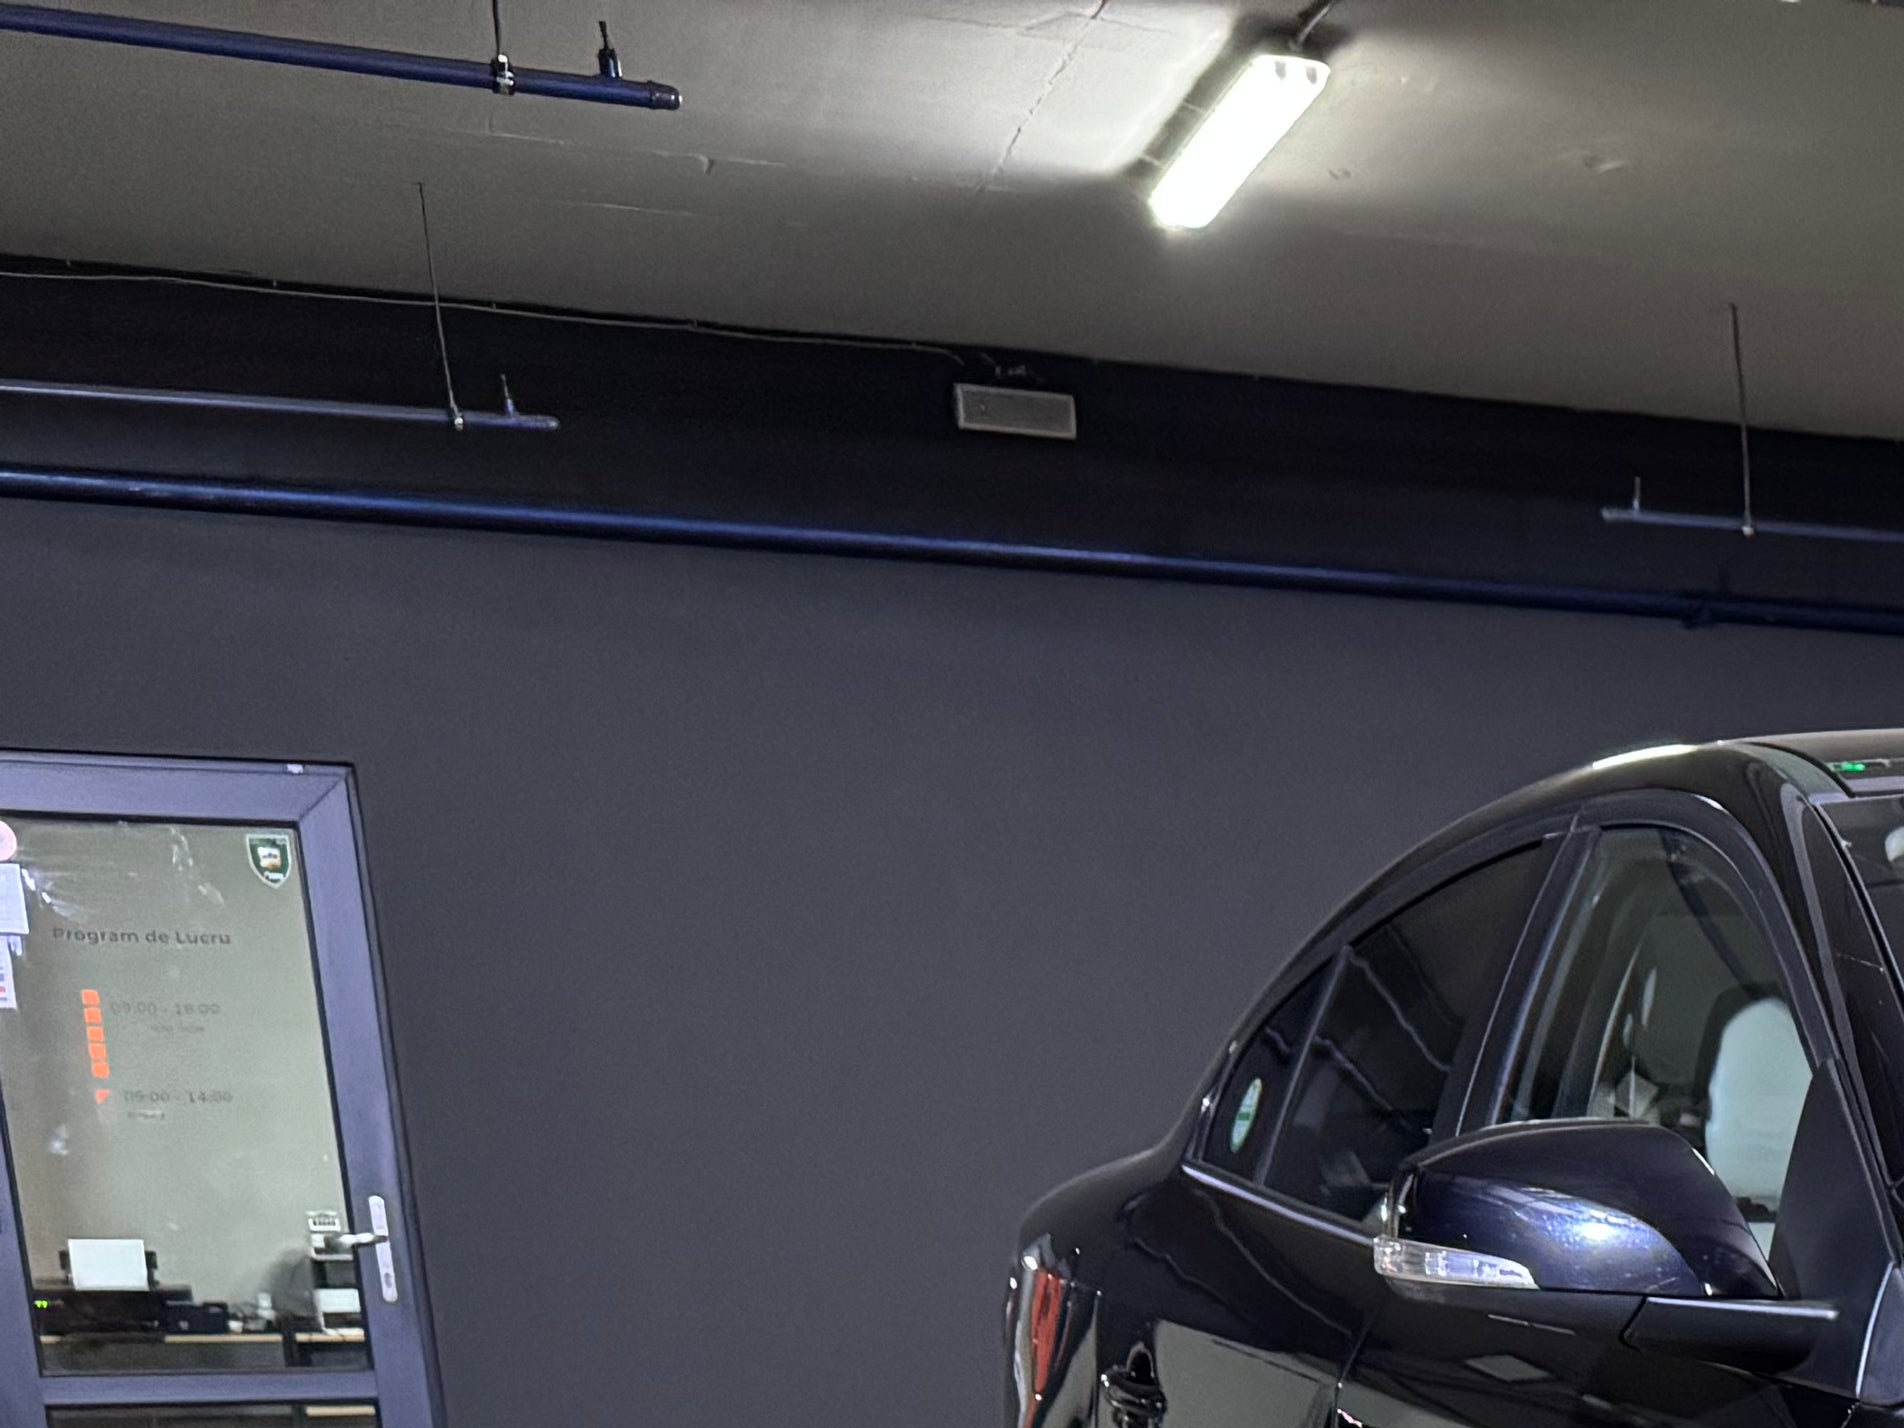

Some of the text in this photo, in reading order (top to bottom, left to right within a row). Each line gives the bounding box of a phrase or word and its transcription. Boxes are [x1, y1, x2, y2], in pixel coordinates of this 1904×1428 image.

[52, 927, 231, 945] Program de Lucru
